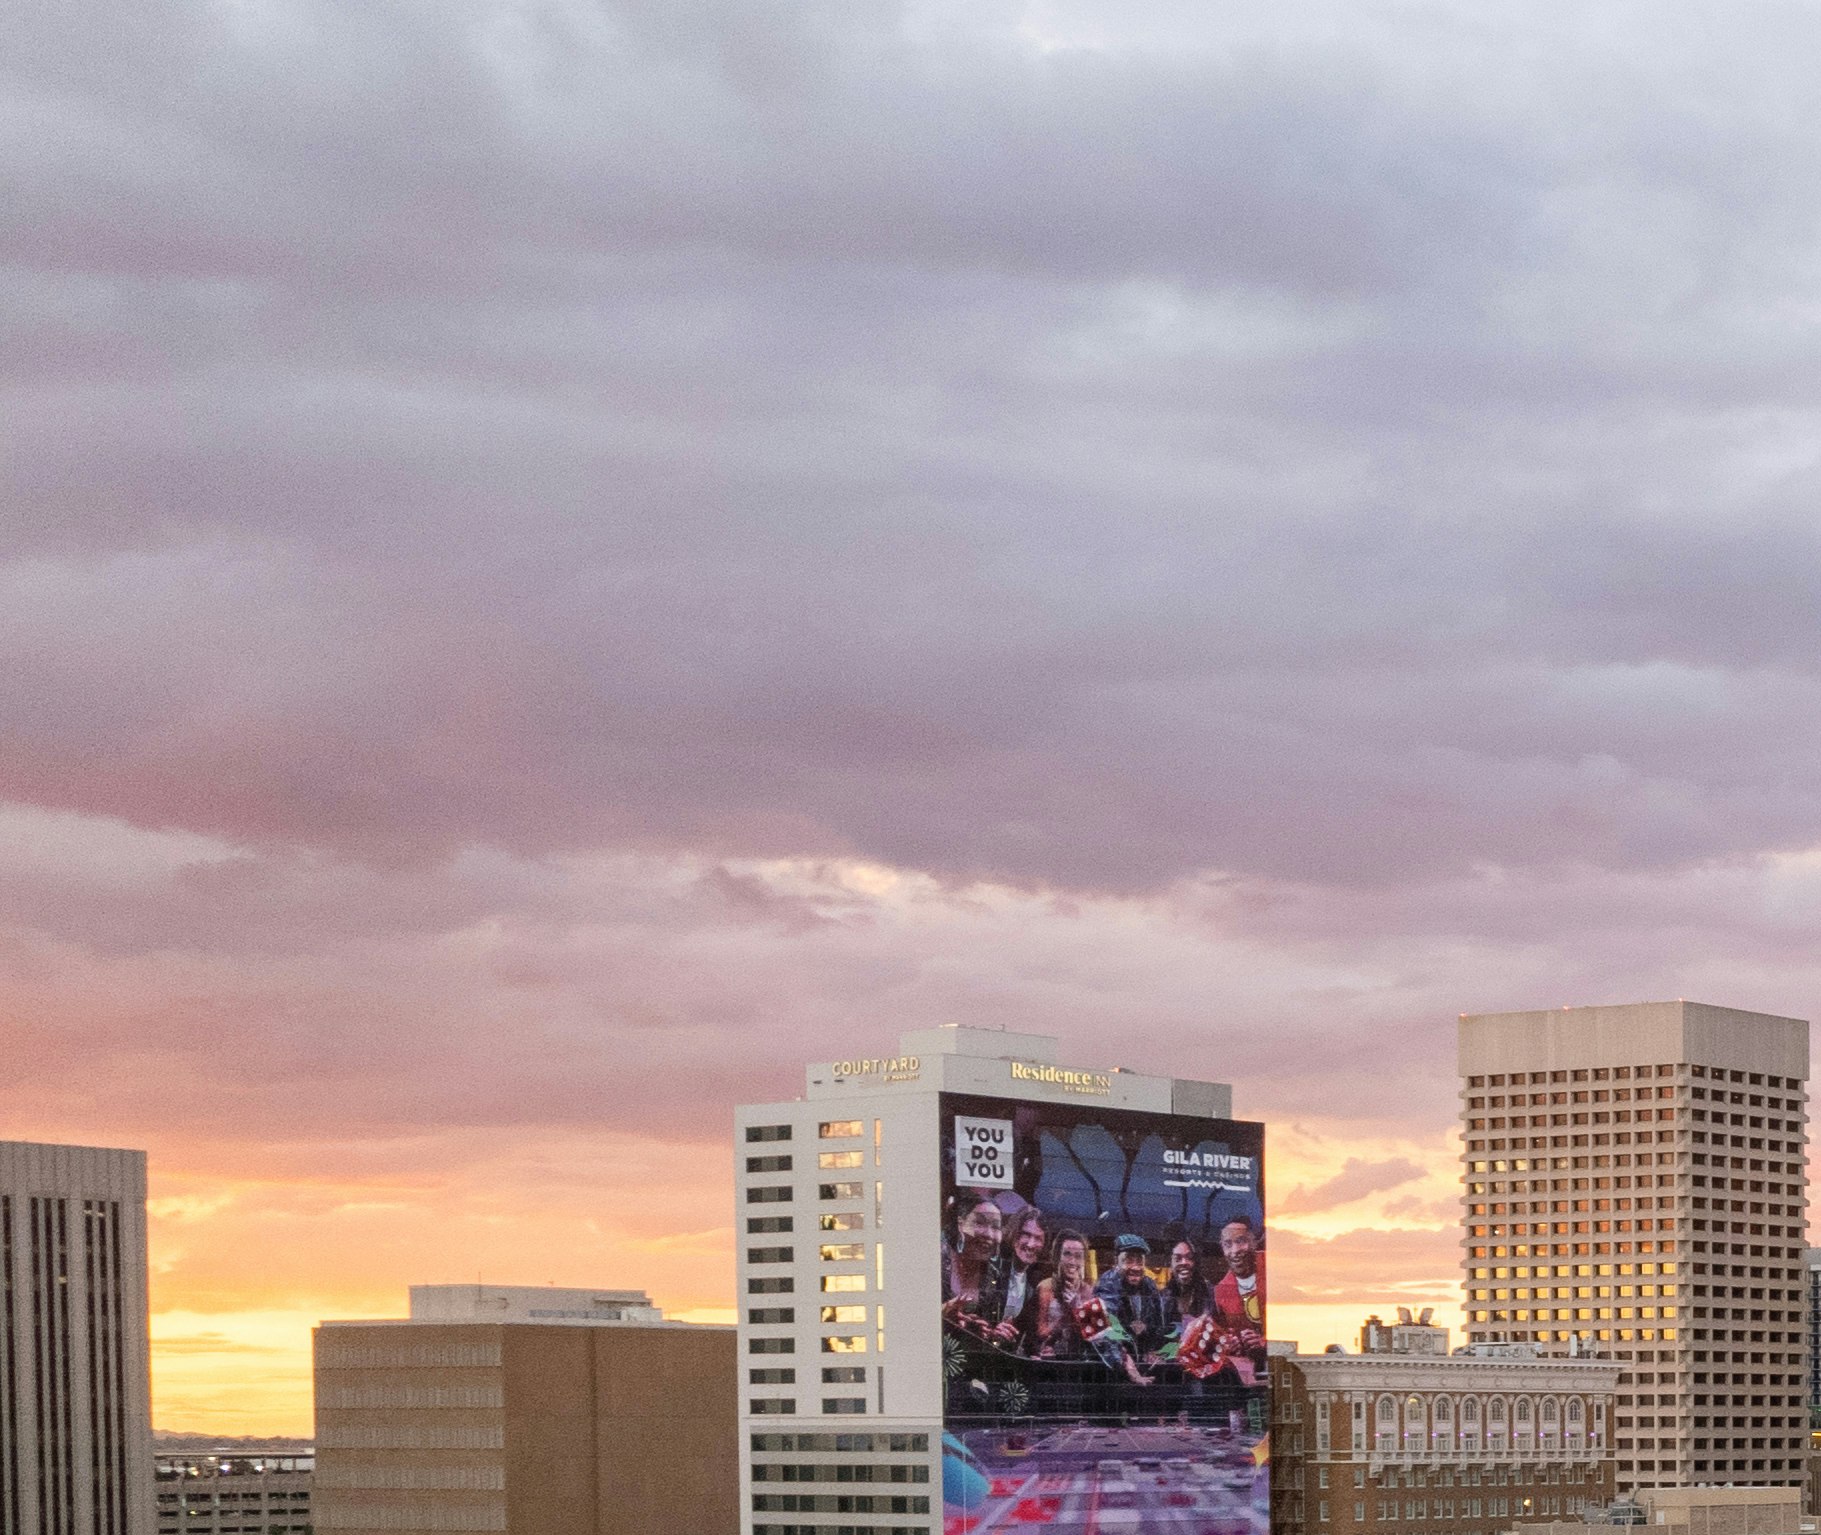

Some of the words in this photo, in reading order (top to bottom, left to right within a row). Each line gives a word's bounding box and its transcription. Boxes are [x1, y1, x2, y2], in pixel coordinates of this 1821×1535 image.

[832, 1056, 919, 1076] COURTYARD
[1011, 1062, 1091, 1085] Residence
[964, 1126, 1004, 1143] YOU
[971, 1145, 998, 1161] DO
[1163, 1150, 1201, 1166] GILA
[1203, 1153, 1251, 1170] RIVER
[965, 1162, 1005, 1179] YOU
